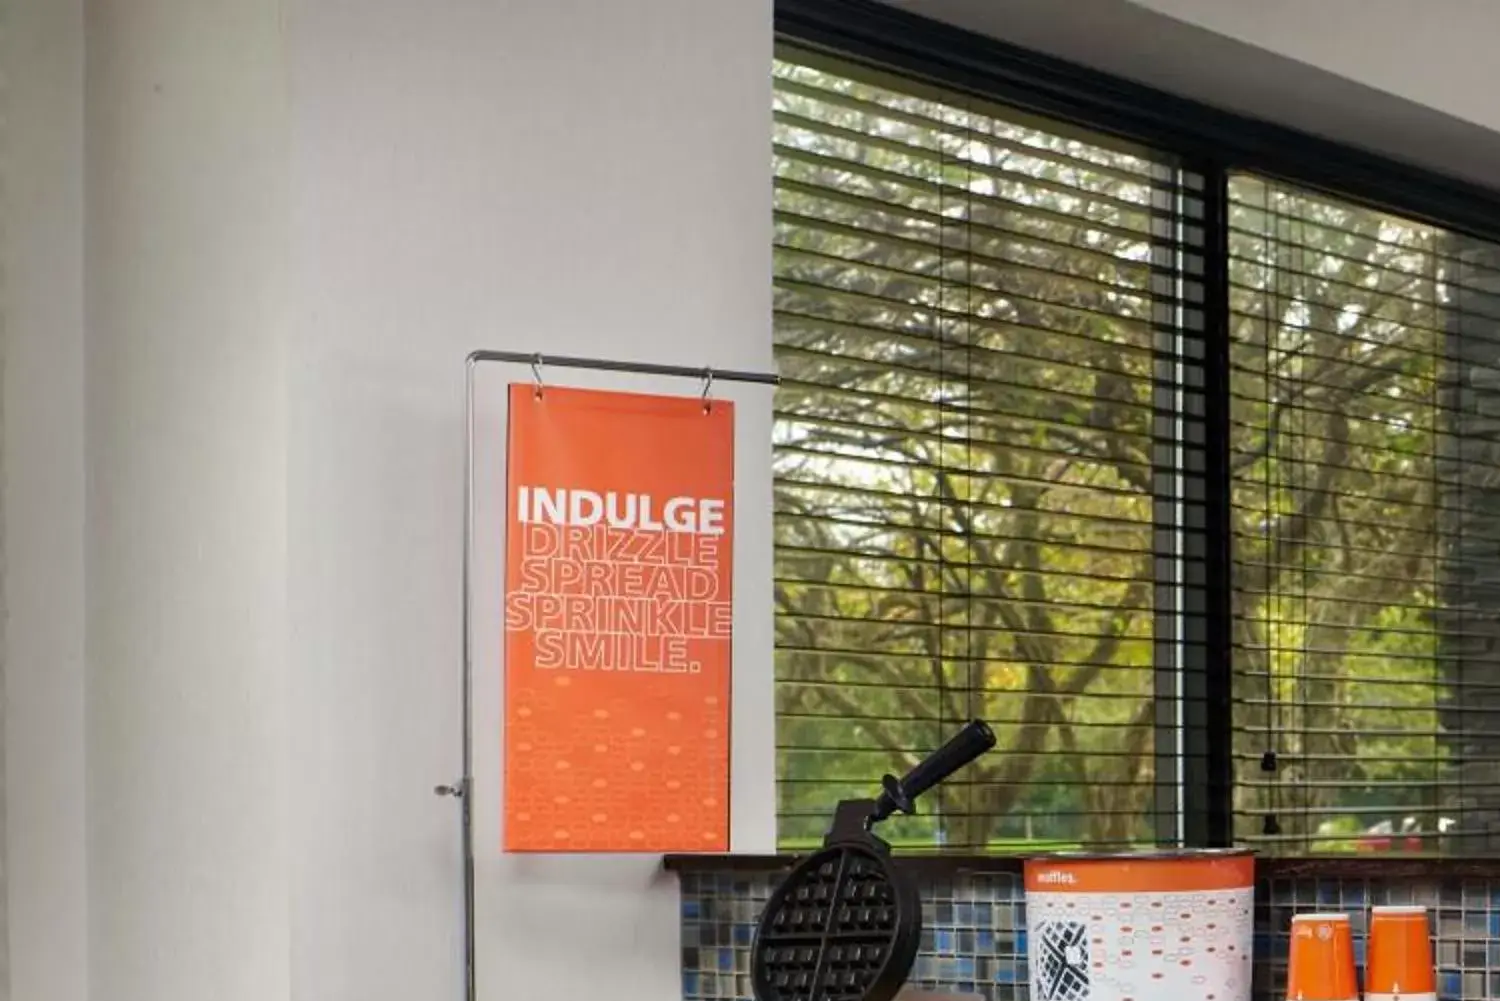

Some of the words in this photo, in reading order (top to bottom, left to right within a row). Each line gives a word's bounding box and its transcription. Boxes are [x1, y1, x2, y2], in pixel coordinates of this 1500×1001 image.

[518, 486, 724, 534] INDULGE
[523, 521, 719, 567] DRIZZLE
[520, 558, 719, 601] SPREAD
[505, 592, 732, 638] SPRINKLE
[535, 628, 701, 673] SMILE.
